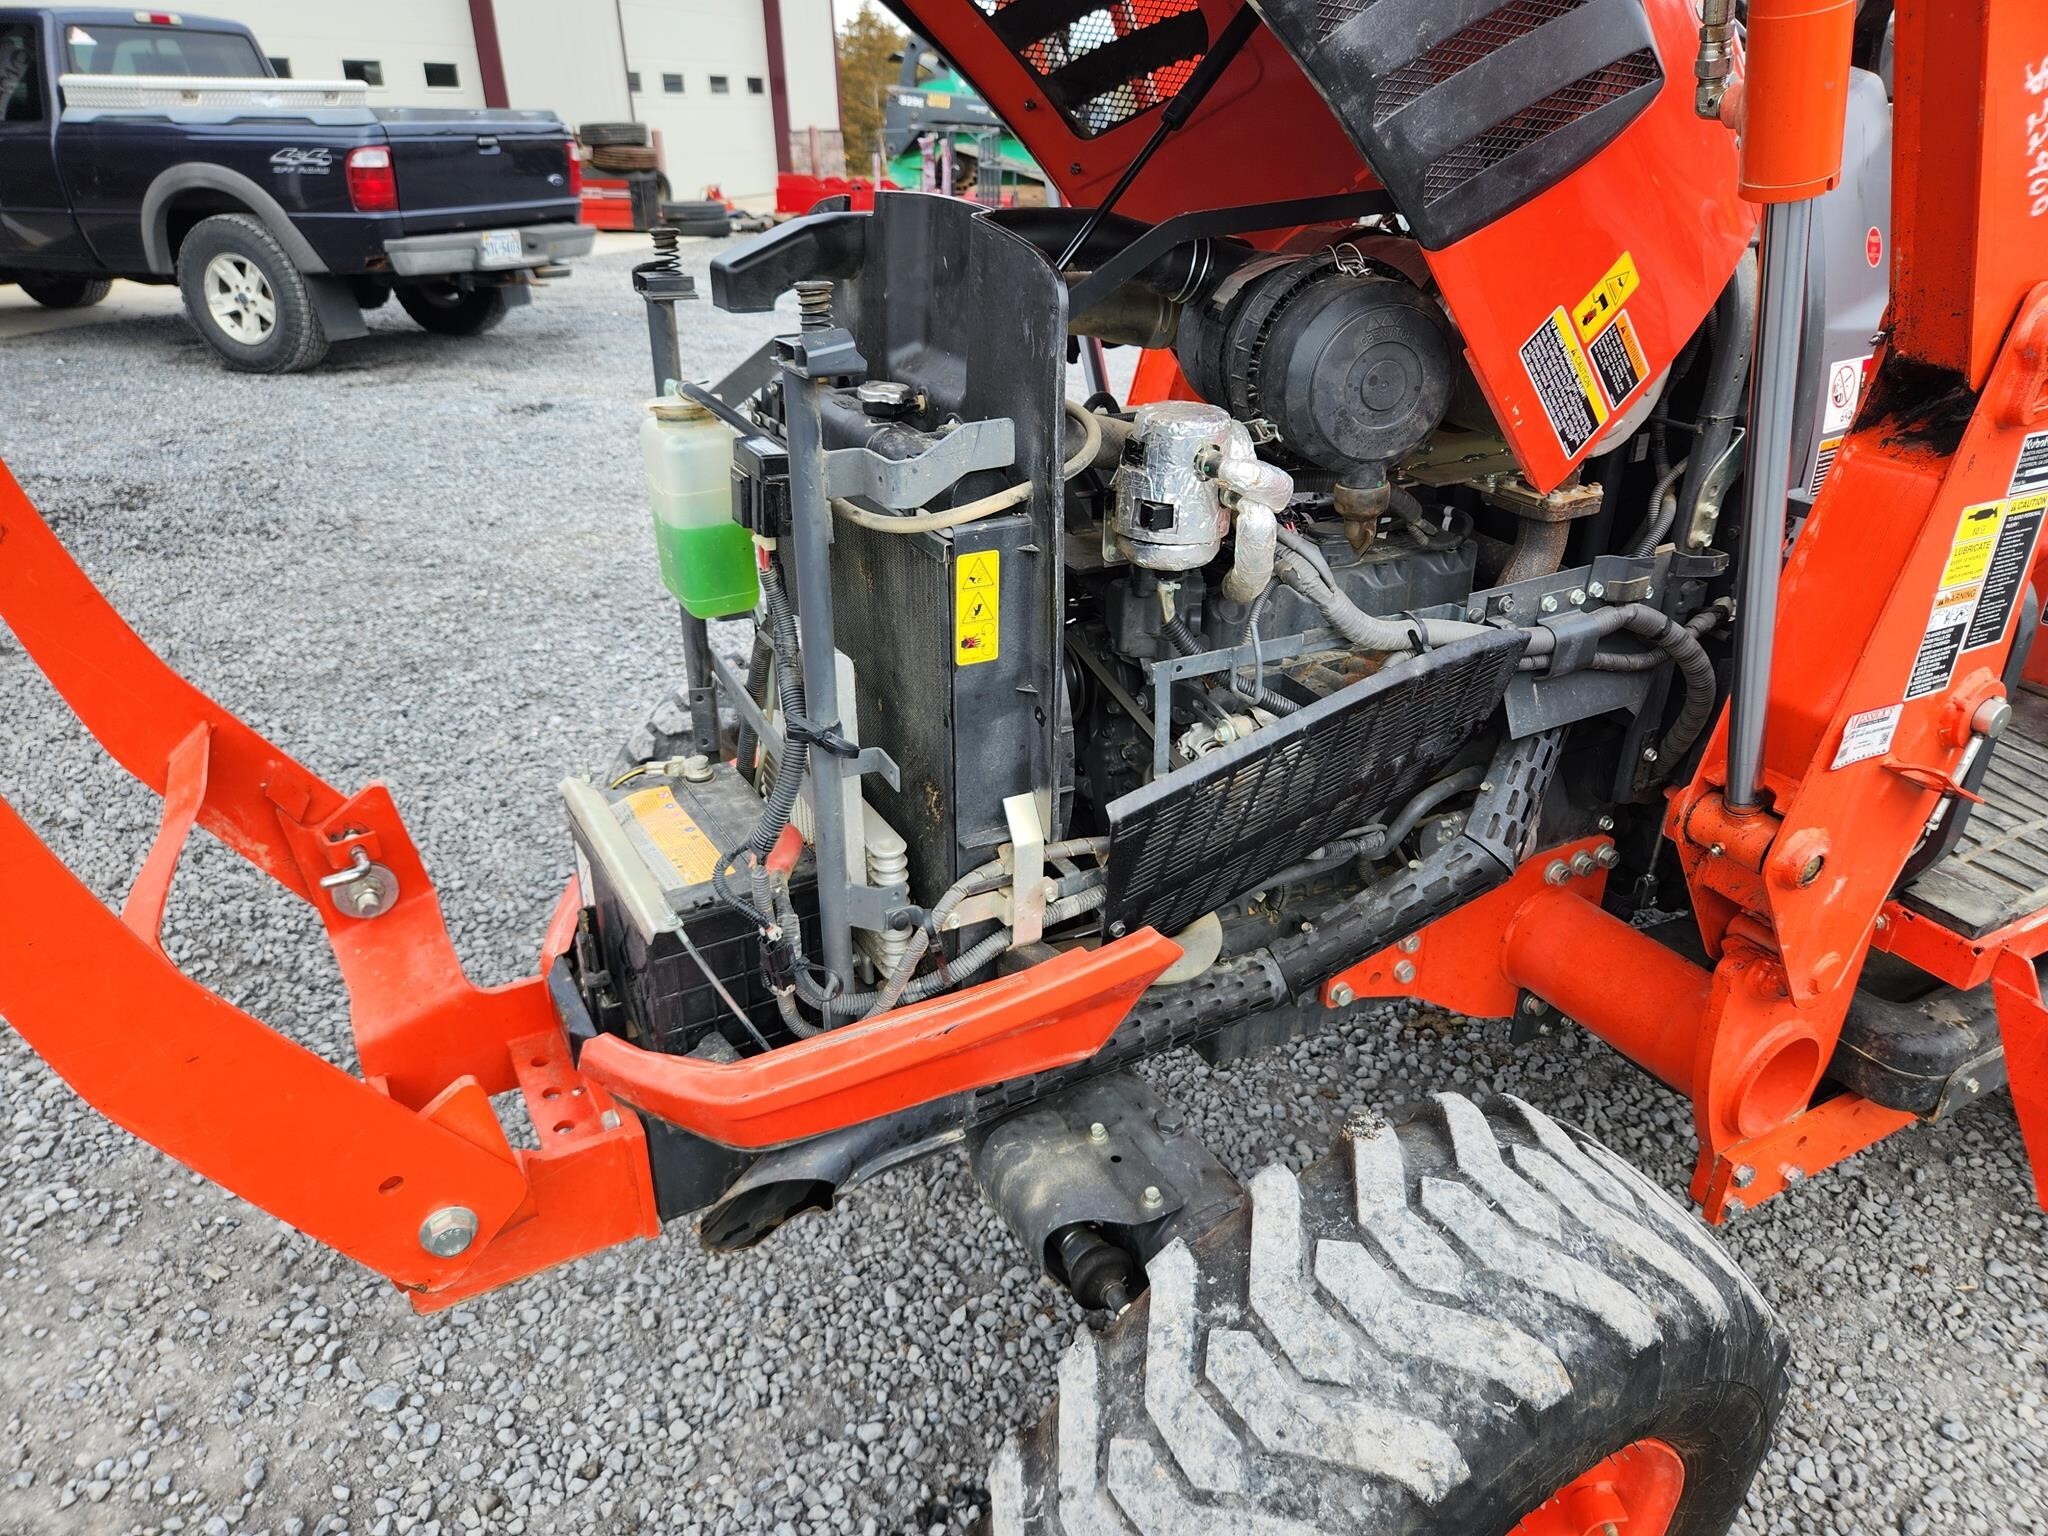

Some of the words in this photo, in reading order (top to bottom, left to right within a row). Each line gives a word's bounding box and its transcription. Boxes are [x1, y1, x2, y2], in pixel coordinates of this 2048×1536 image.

[1573, 354, 1592, 389] CAUTION
[2017, 498, 2047, 510] CAUTION
[1954, 541, 1992, 557] LUBRICATE
